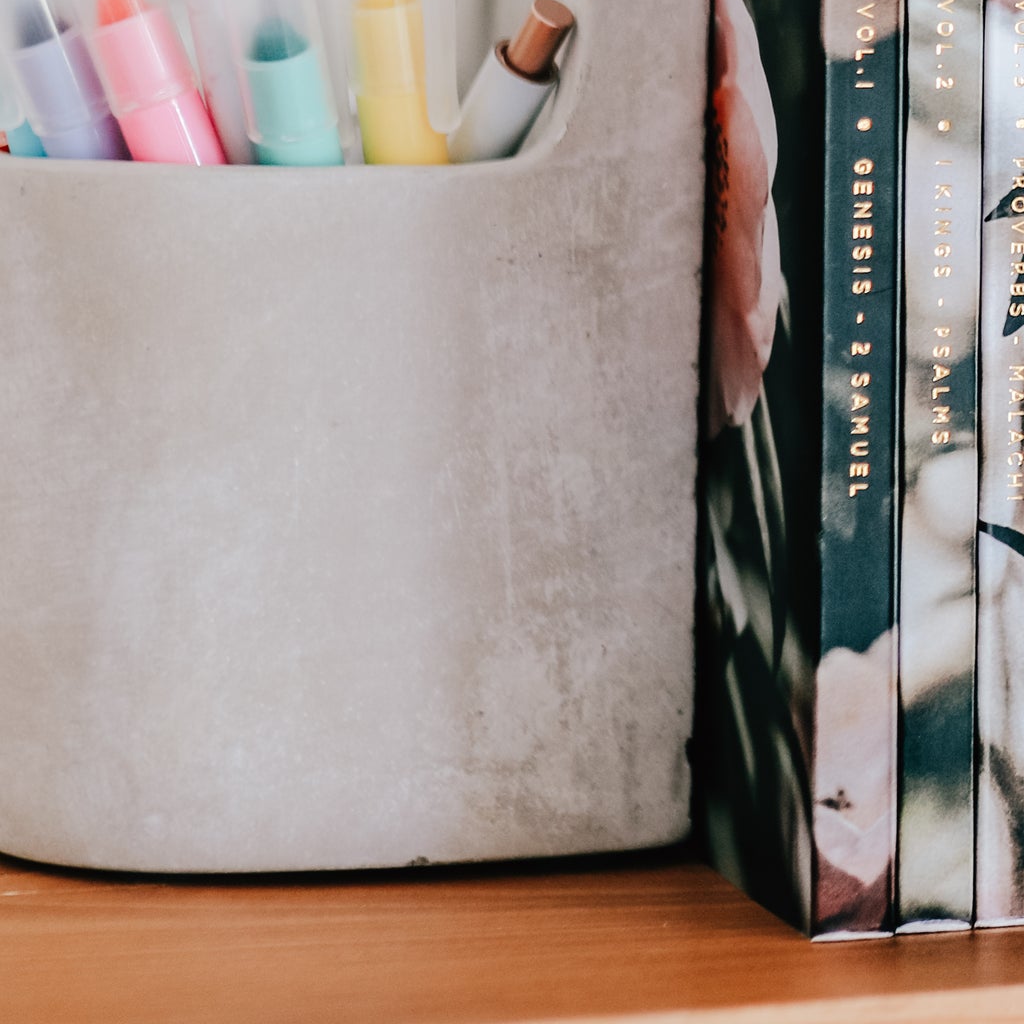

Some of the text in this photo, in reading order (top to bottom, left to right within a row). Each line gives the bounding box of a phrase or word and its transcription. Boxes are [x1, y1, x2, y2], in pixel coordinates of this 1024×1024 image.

[852, 157, 875, 296] GENESIS
[933, 183, 953, 278] KINGS
[851, 341, 873, 357] 2
[931, 326, 952, 446] PSALMS
[849, 372, 871, 498] SAMUEL
